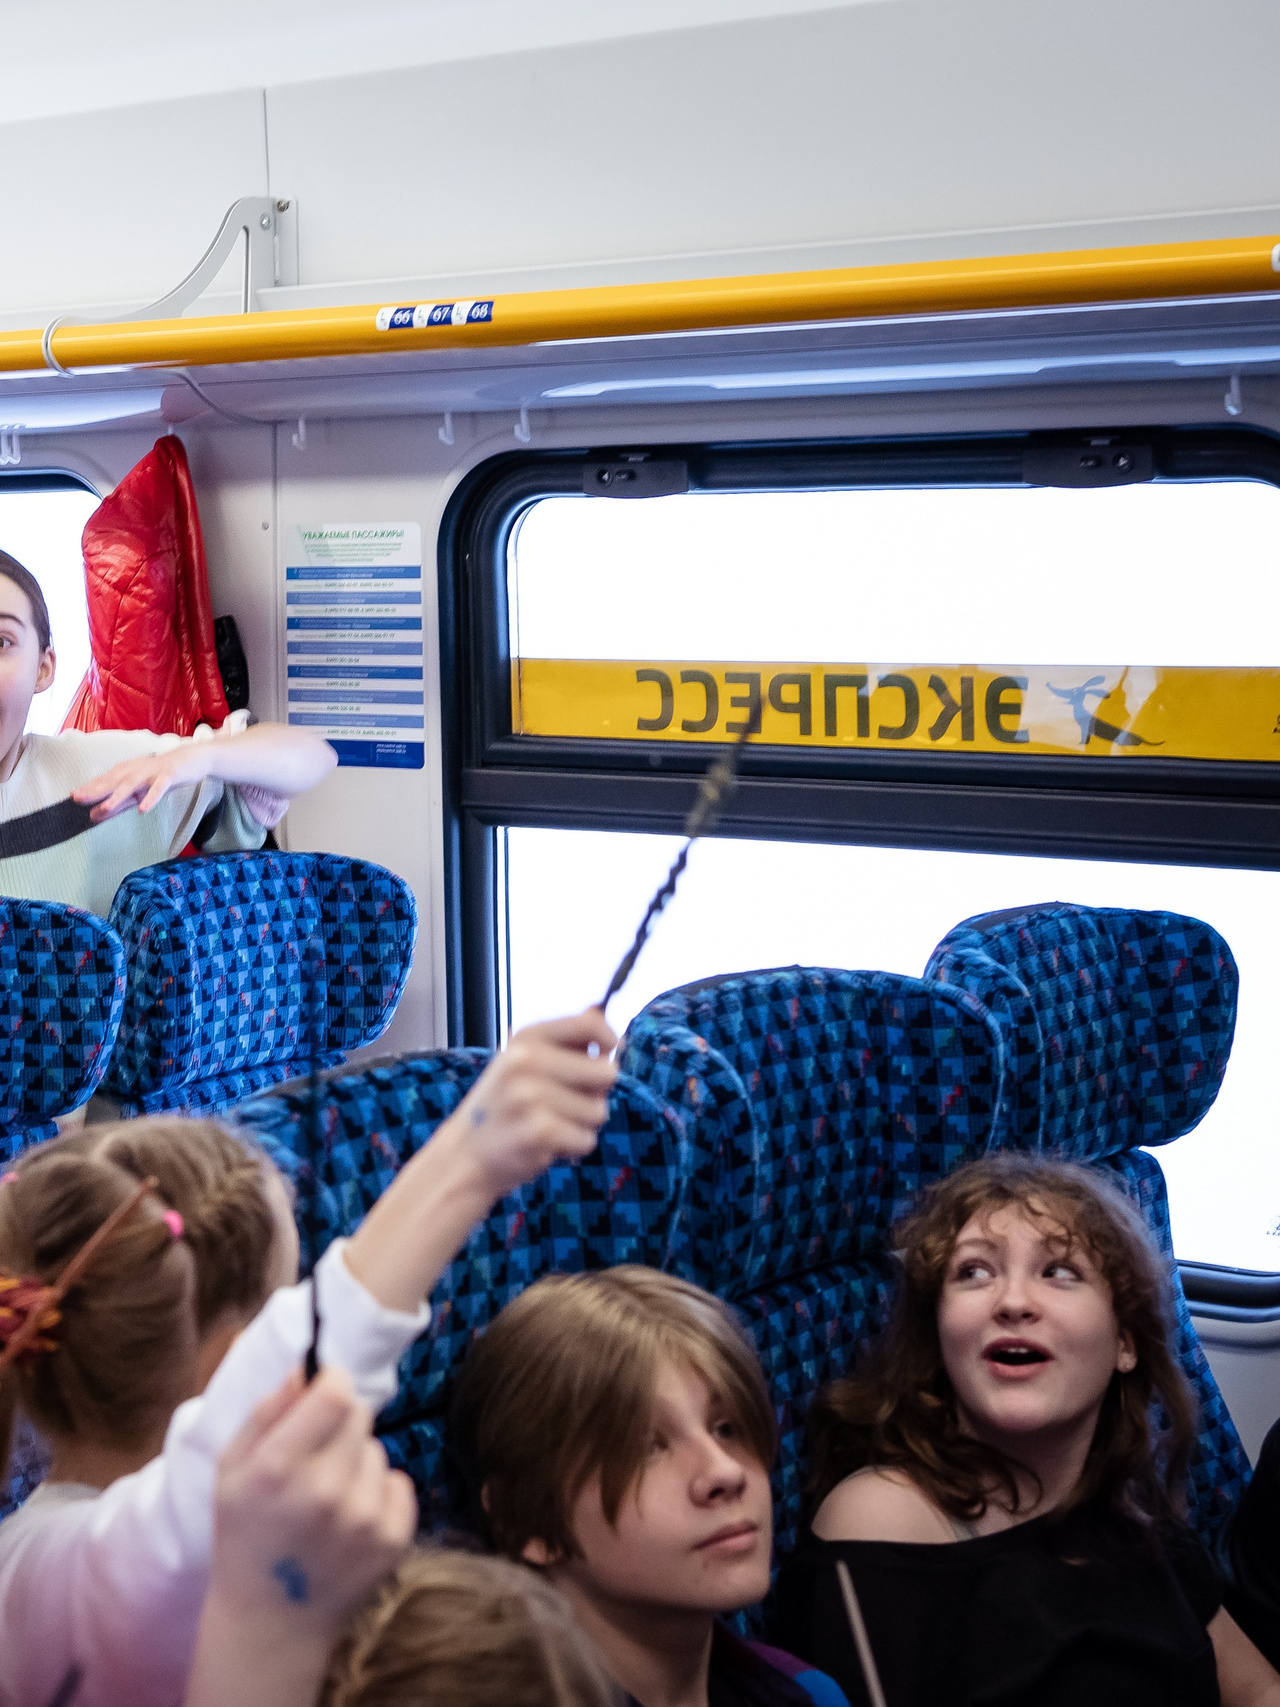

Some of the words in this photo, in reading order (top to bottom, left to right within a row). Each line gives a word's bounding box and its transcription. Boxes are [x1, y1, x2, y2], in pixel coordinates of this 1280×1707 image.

[393, 309, 410, 325] 66
[432, 307, 450, 322] 67
[471, 303, 489, 319] 68
